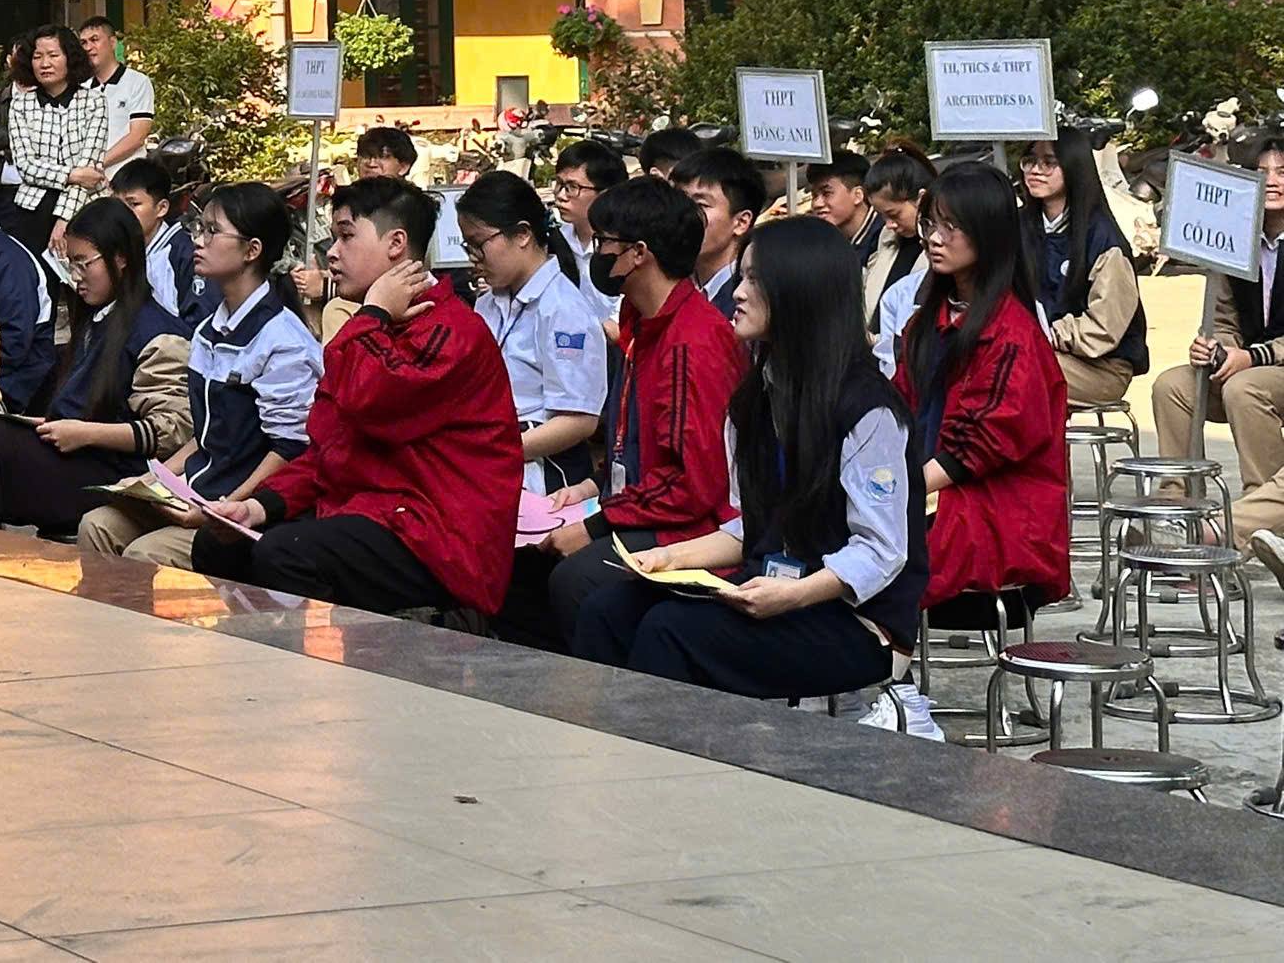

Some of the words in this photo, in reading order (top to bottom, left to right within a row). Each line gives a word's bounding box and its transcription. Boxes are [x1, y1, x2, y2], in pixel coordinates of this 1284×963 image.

[306, 60, 325, 75] THPT
[961, 62, 990, 74] THCS
[1003, 60, 1032, 73] THPT
[763, 90, 795, 106] THPT
[945, 94, 1016, 108] ARCHIMEDES
[789, 128, 813, 144] ANH
[1196, 182, 1232, 207] THPT
[1206, 228, 1235, 253] LOA
